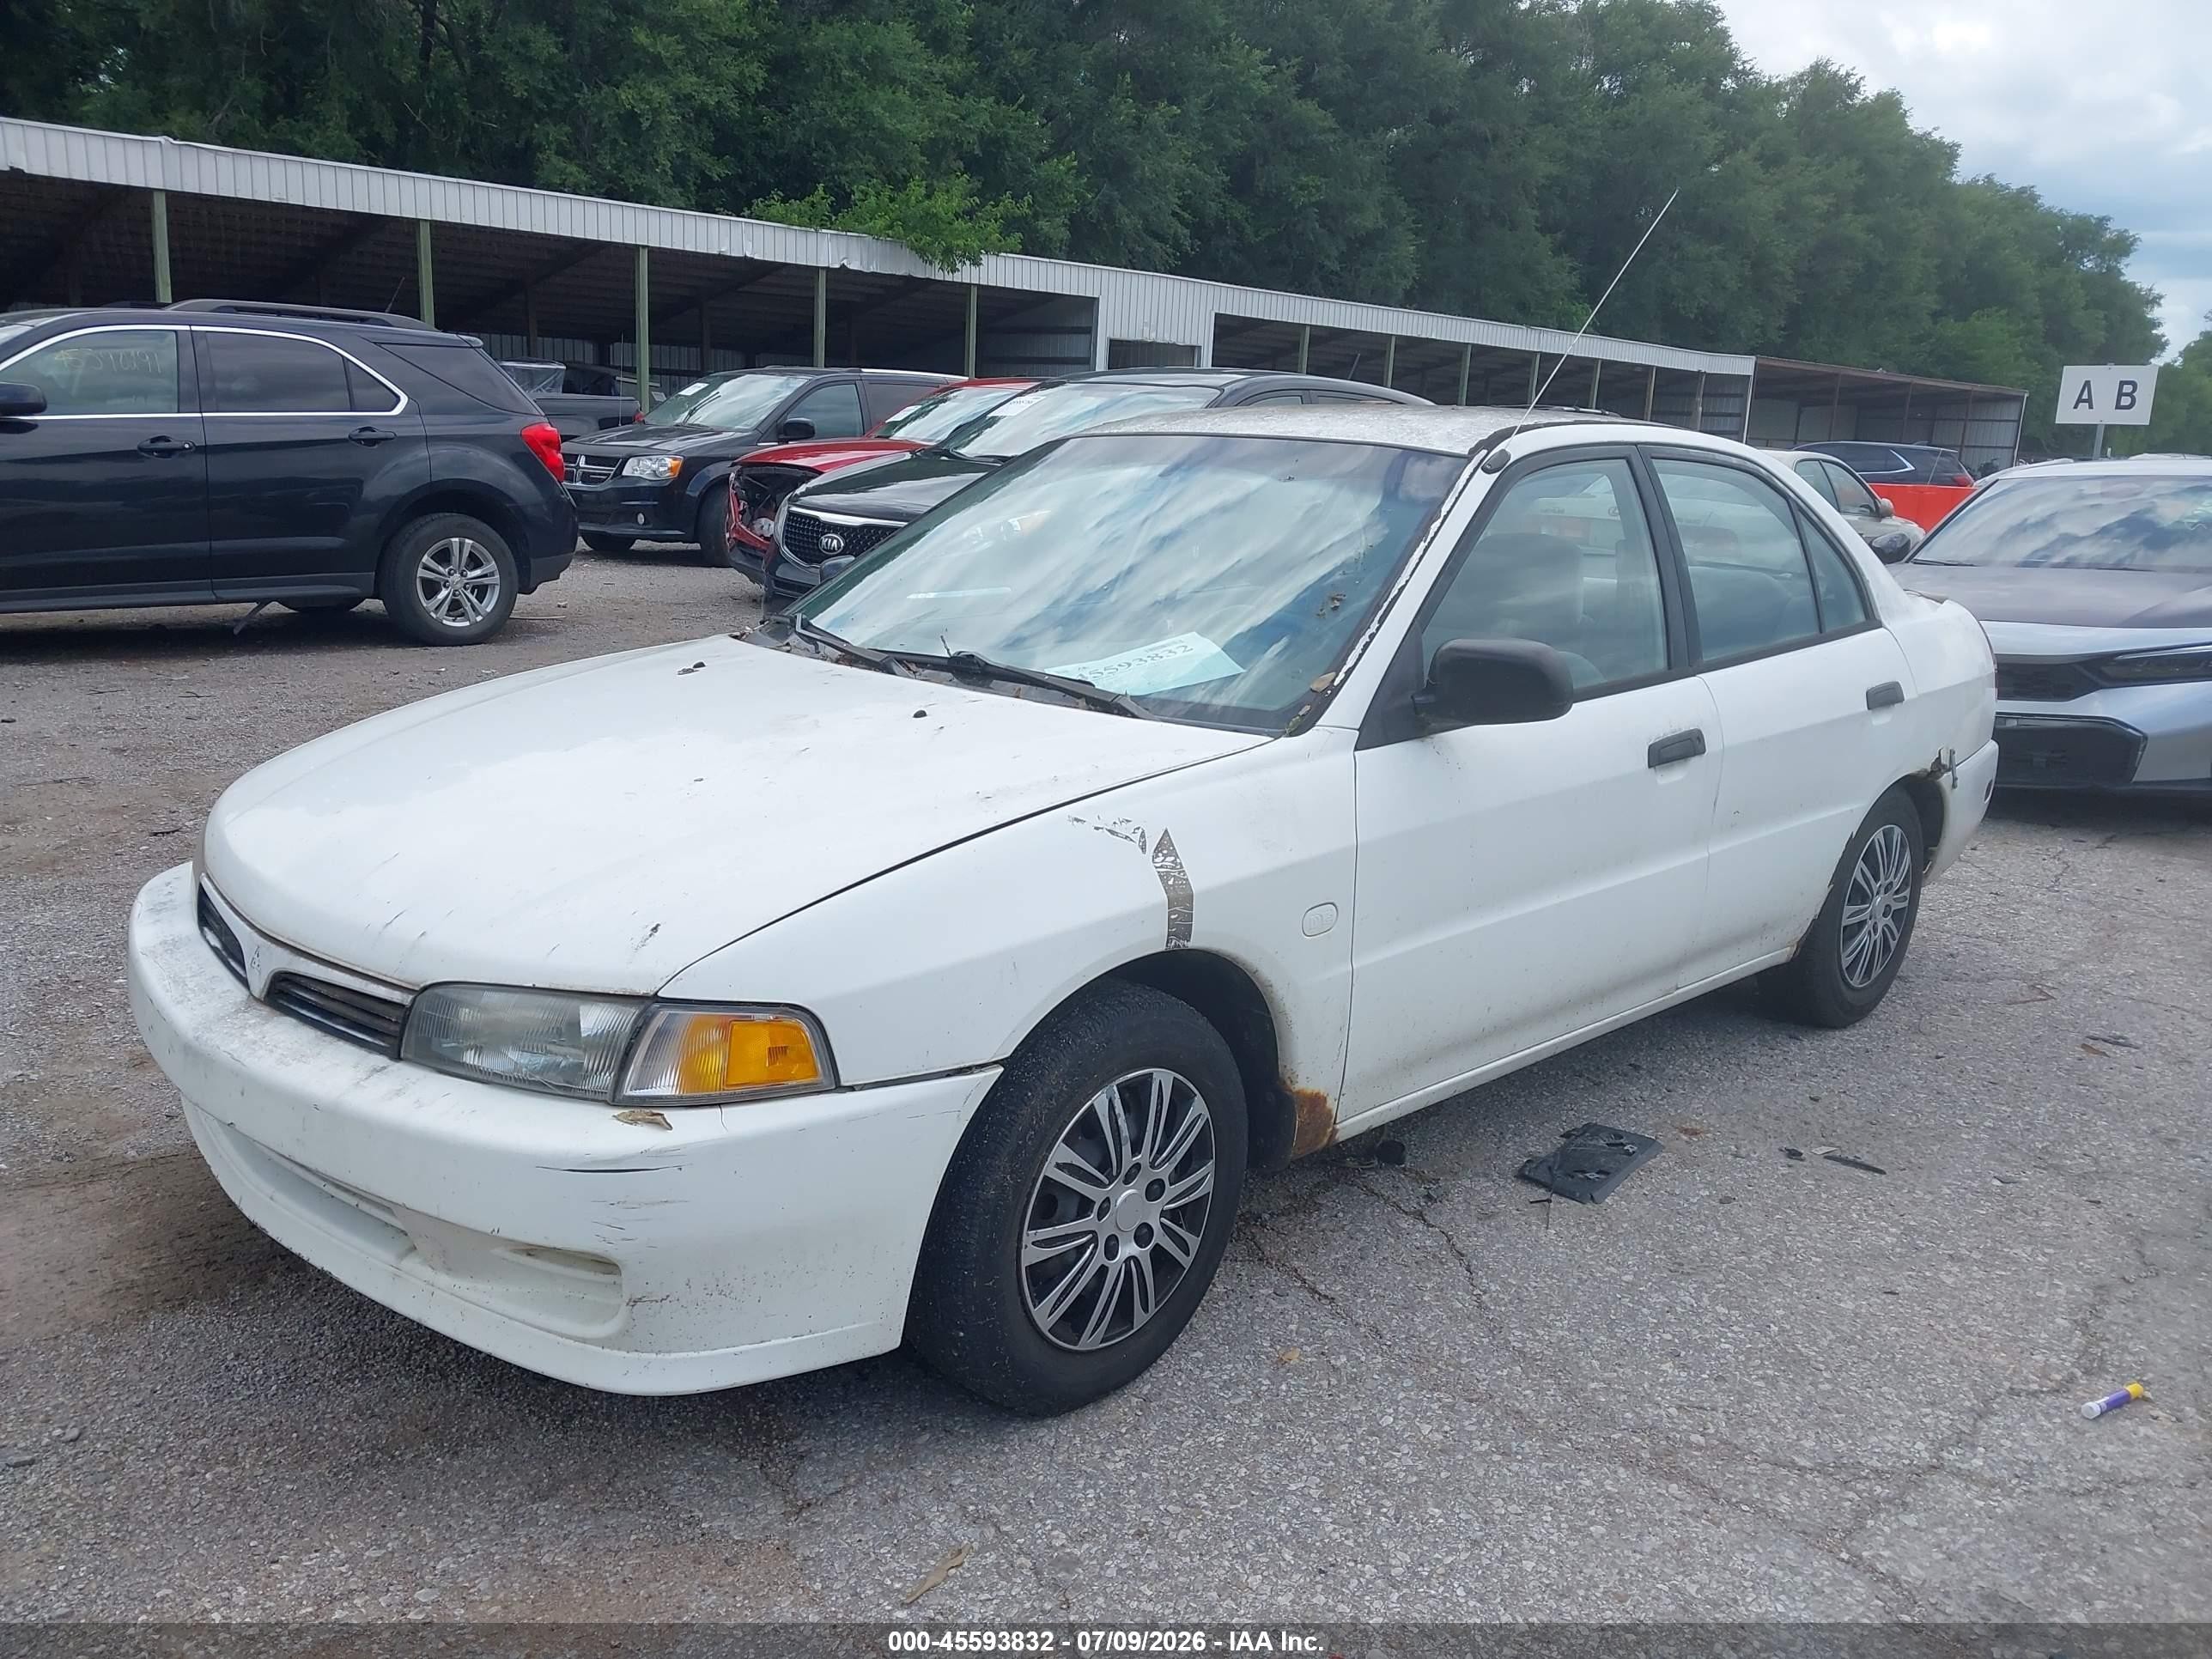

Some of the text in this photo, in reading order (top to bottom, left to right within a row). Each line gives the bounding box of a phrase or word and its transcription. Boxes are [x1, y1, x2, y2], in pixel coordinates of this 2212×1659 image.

[2073, 380, 2138, 410] A B
[821, 538, 838, 551] KIA
